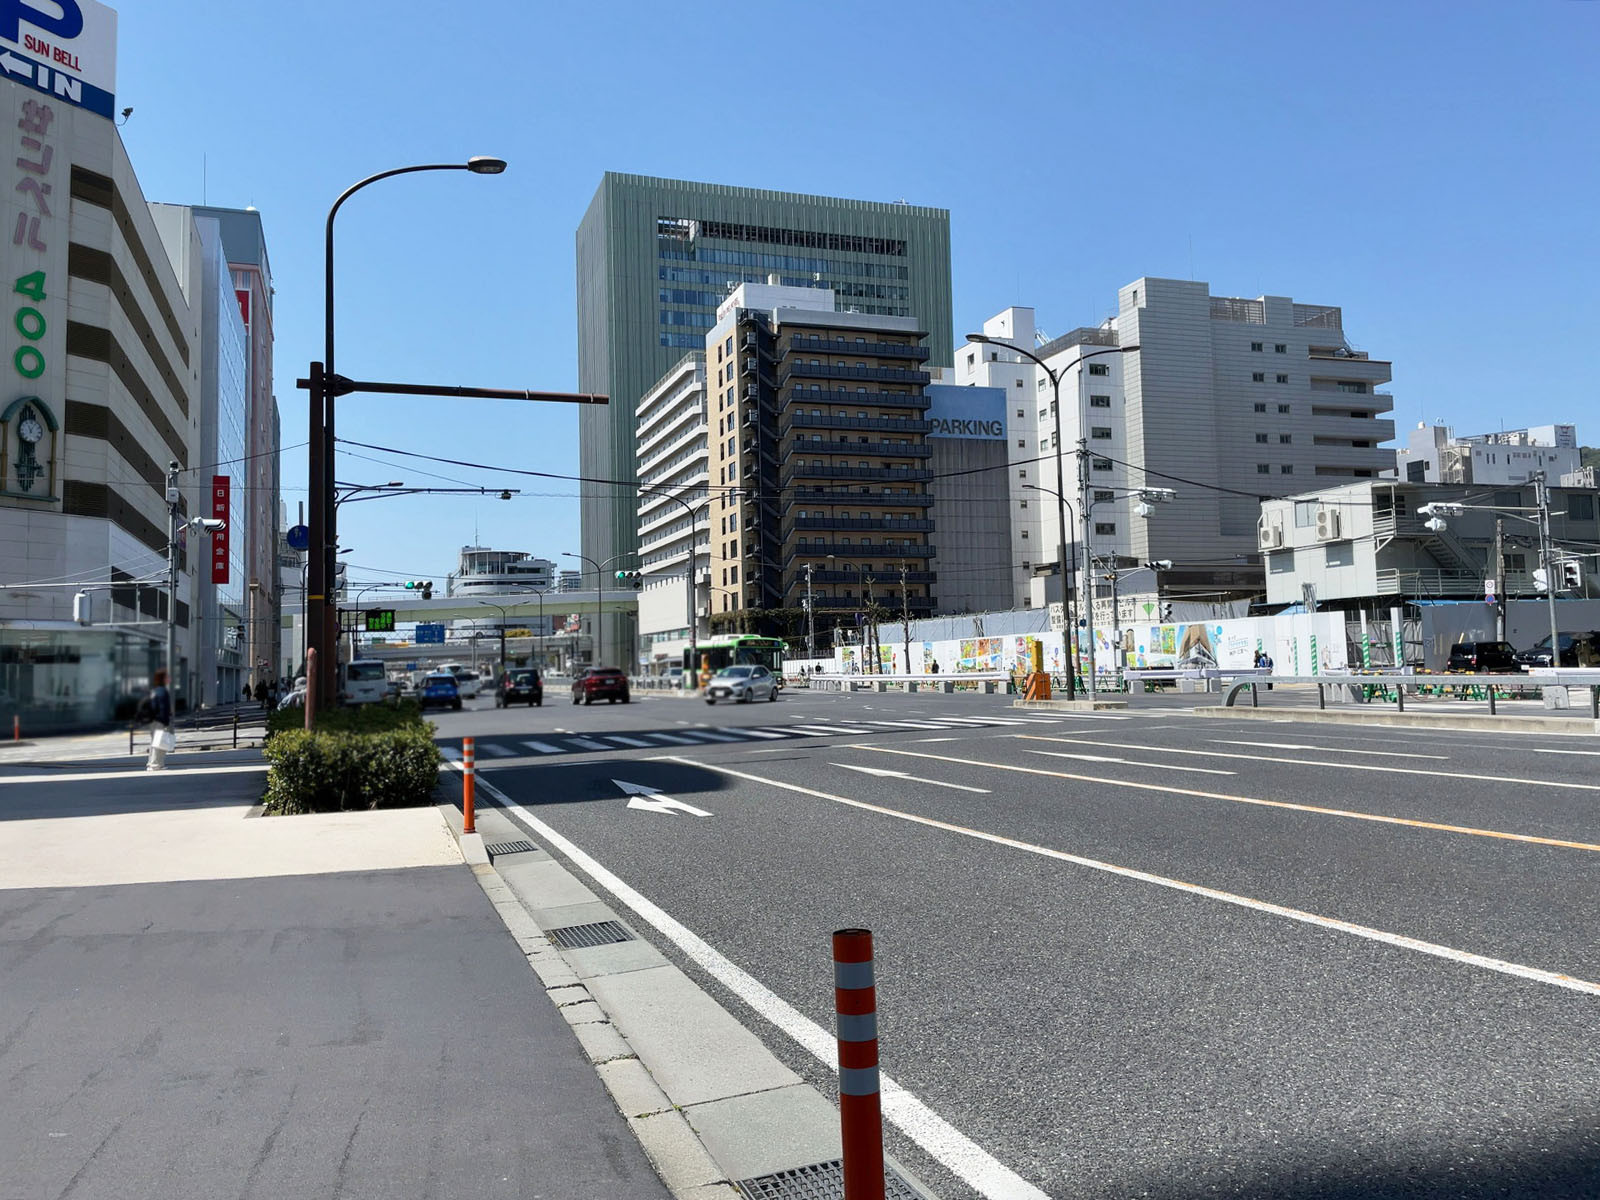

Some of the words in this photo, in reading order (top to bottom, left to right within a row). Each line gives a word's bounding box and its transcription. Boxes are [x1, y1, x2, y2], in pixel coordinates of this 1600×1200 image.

[24, 34, 50, 57] SUN
[53, 46, 82, 72] BELL
[38, 64, 82, 103] IN
[13, 98, 54, 252] サンベル
[13, 270, 47, 380] 400
[931, 418, 1003, 436] PARKING
[215, 489, 225, 570] 日新用金庫
